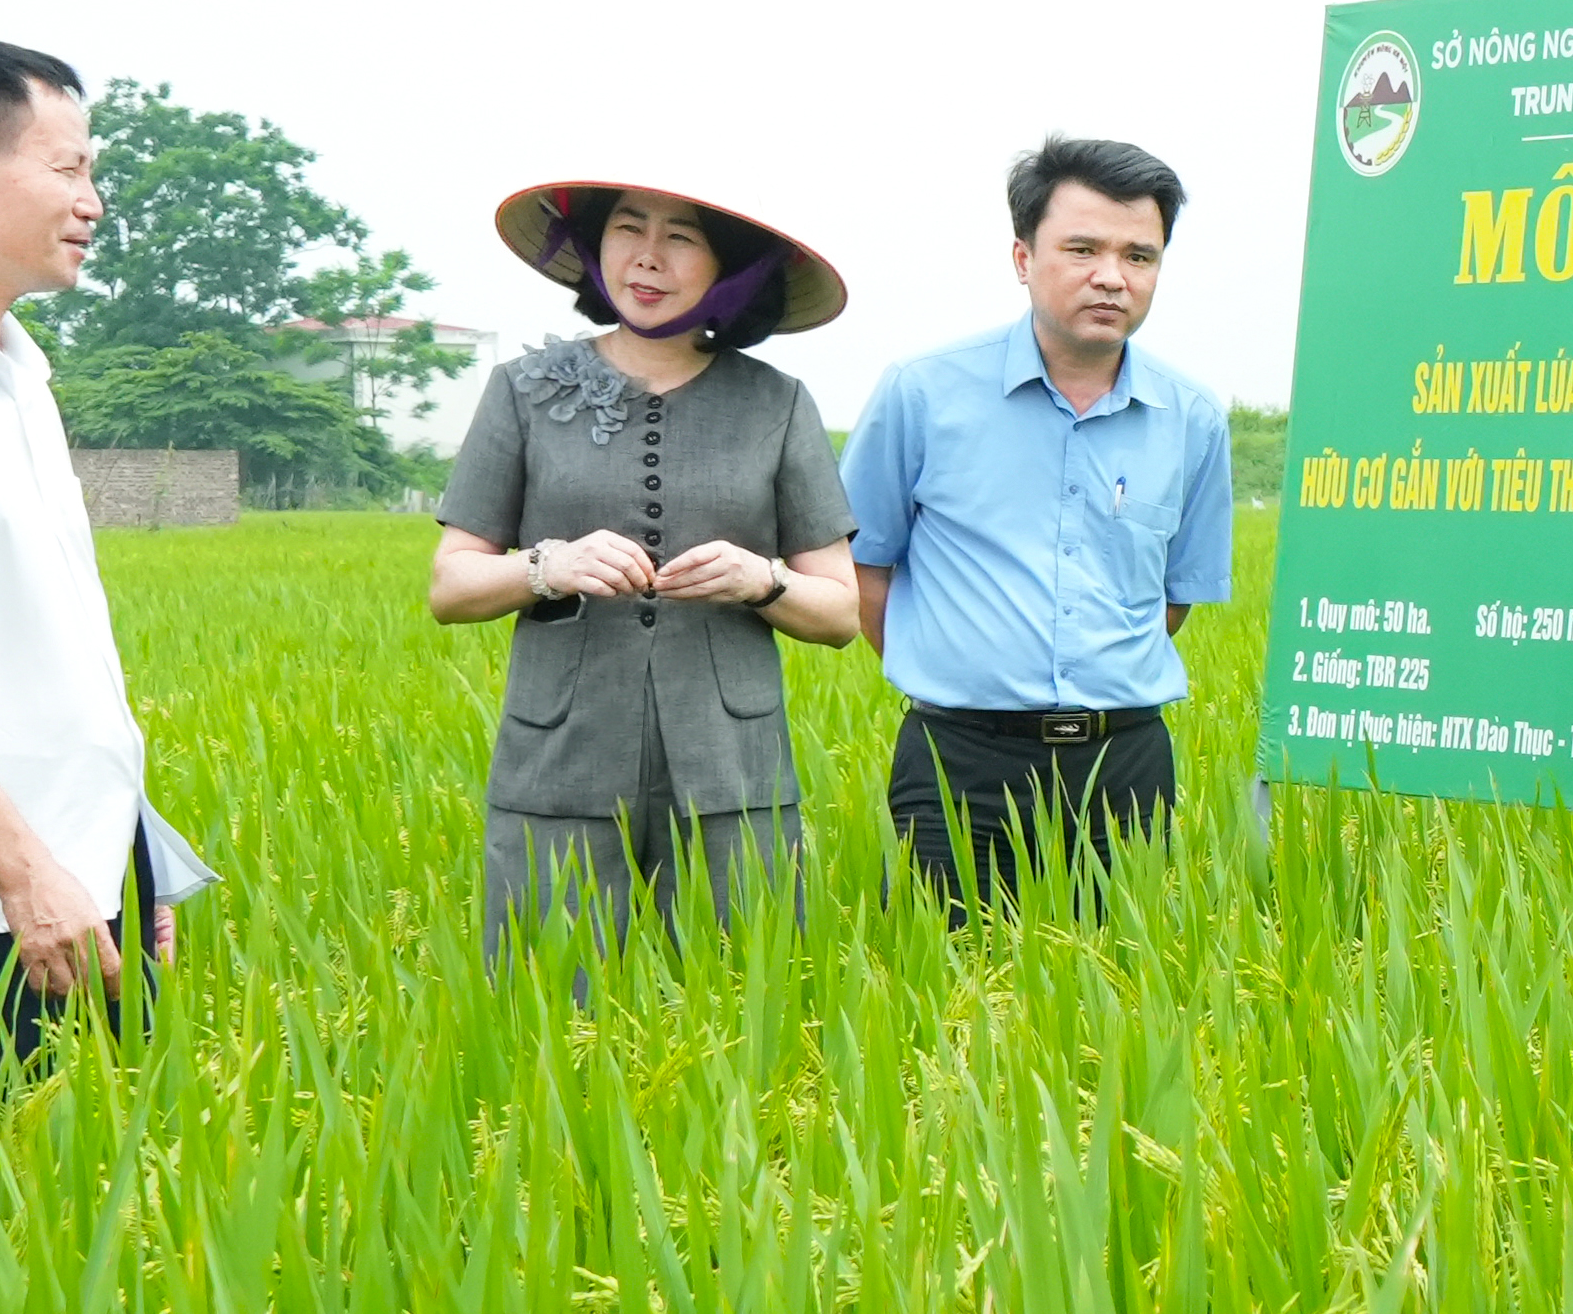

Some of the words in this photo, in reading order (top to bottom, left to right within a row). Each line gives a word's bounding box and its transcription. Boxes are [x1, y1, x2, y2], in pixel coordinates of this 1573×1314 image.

[1432, 29, 1462, 69] SỞ
[1469, 27, 1536, 66] NÔNG
[1413, 344, 1464, 414] SẢN
[1467, 342, 1532, 413] XUẤT
[1300, 448, 1349, 508] HỮU
[1353, 453, 1387, 509] CƠ
[1390, 439, 1440, 509] GẮN
[1446, 448, 1485, 511] VỚI
[1491, 448, 1543, 512] TIÊU
[1301, 598, 1312, 627] 1.
[1318, 598, 1347, 633] Quy
[1350, 599, 1380, 631] mô:
[1384, 601, 1404, 632] 50
[1407, 602, 1431, 634] ha.
[1476, 601, 1499, 637] Số
[1501, 606, 1528, 645] hộ:
[1531, 608, 1564, 640] 250
[1293, 651, 1307, 681] 2.
[1312, 648, 1362, 688] Giống:
[1367, 655, 1396, 687] TBR
[1398, 658, 1429, 690] 225
[1288, 705, 1302, 735] 3.
[1306, 706, 1337, 739] Đơn
[1341, 709, 1355, 747] vị
[1358, 711, 1393, 749] thực
[1396, 713, 1437, 753] hiện:
[1441, 716, 1474, 749] HTX
[1476, 717, 1508, 752] Đào
[1514, 721, 1554, 761] Thục
